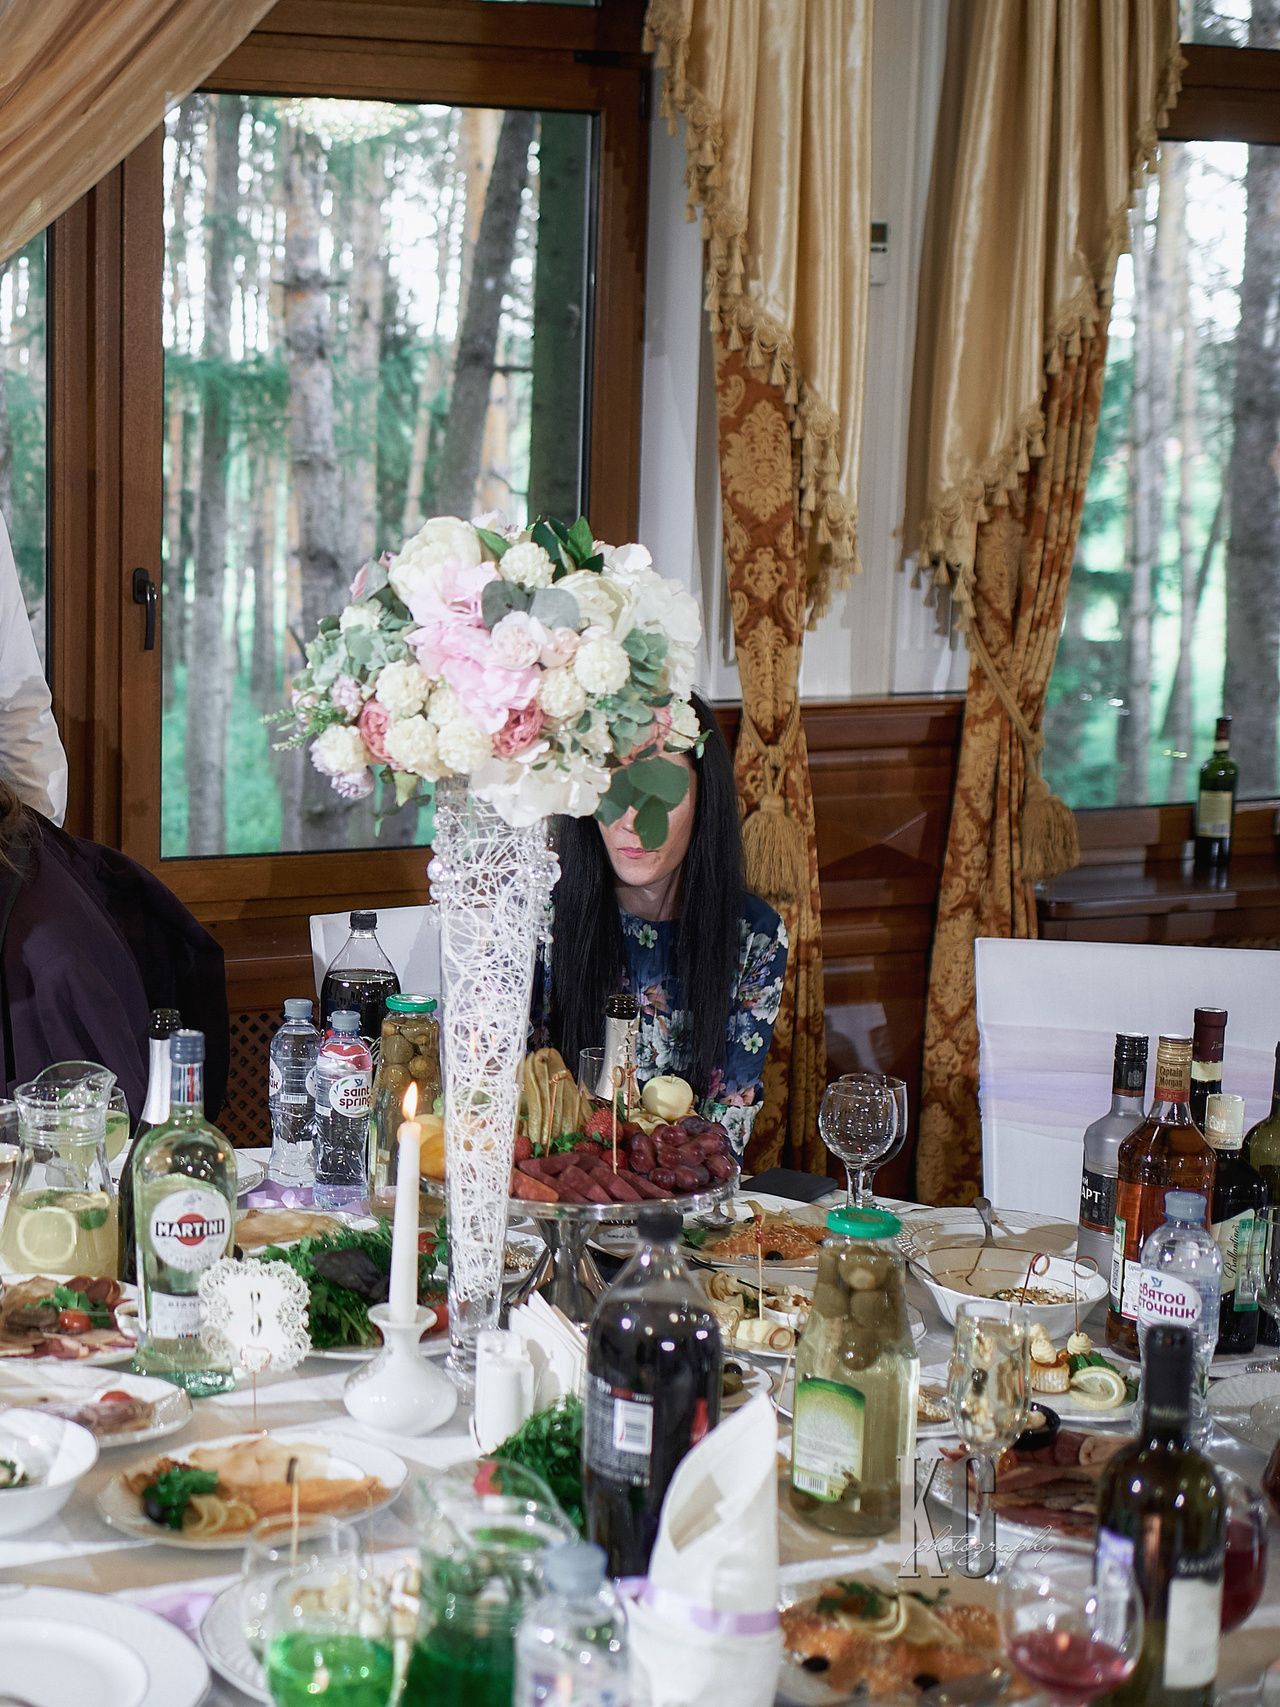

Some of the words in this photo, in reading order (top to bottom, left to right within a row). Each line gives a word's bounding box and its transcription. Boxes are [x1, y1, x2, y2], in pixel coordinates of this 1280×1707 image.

[1159, 1065, 1183, 1078] Captain
[1158, 1076, 1183, 1088] Morgan
[343, 1084, 370, 1097] saint
[156, 1219, 224, 1238] MARTINI
